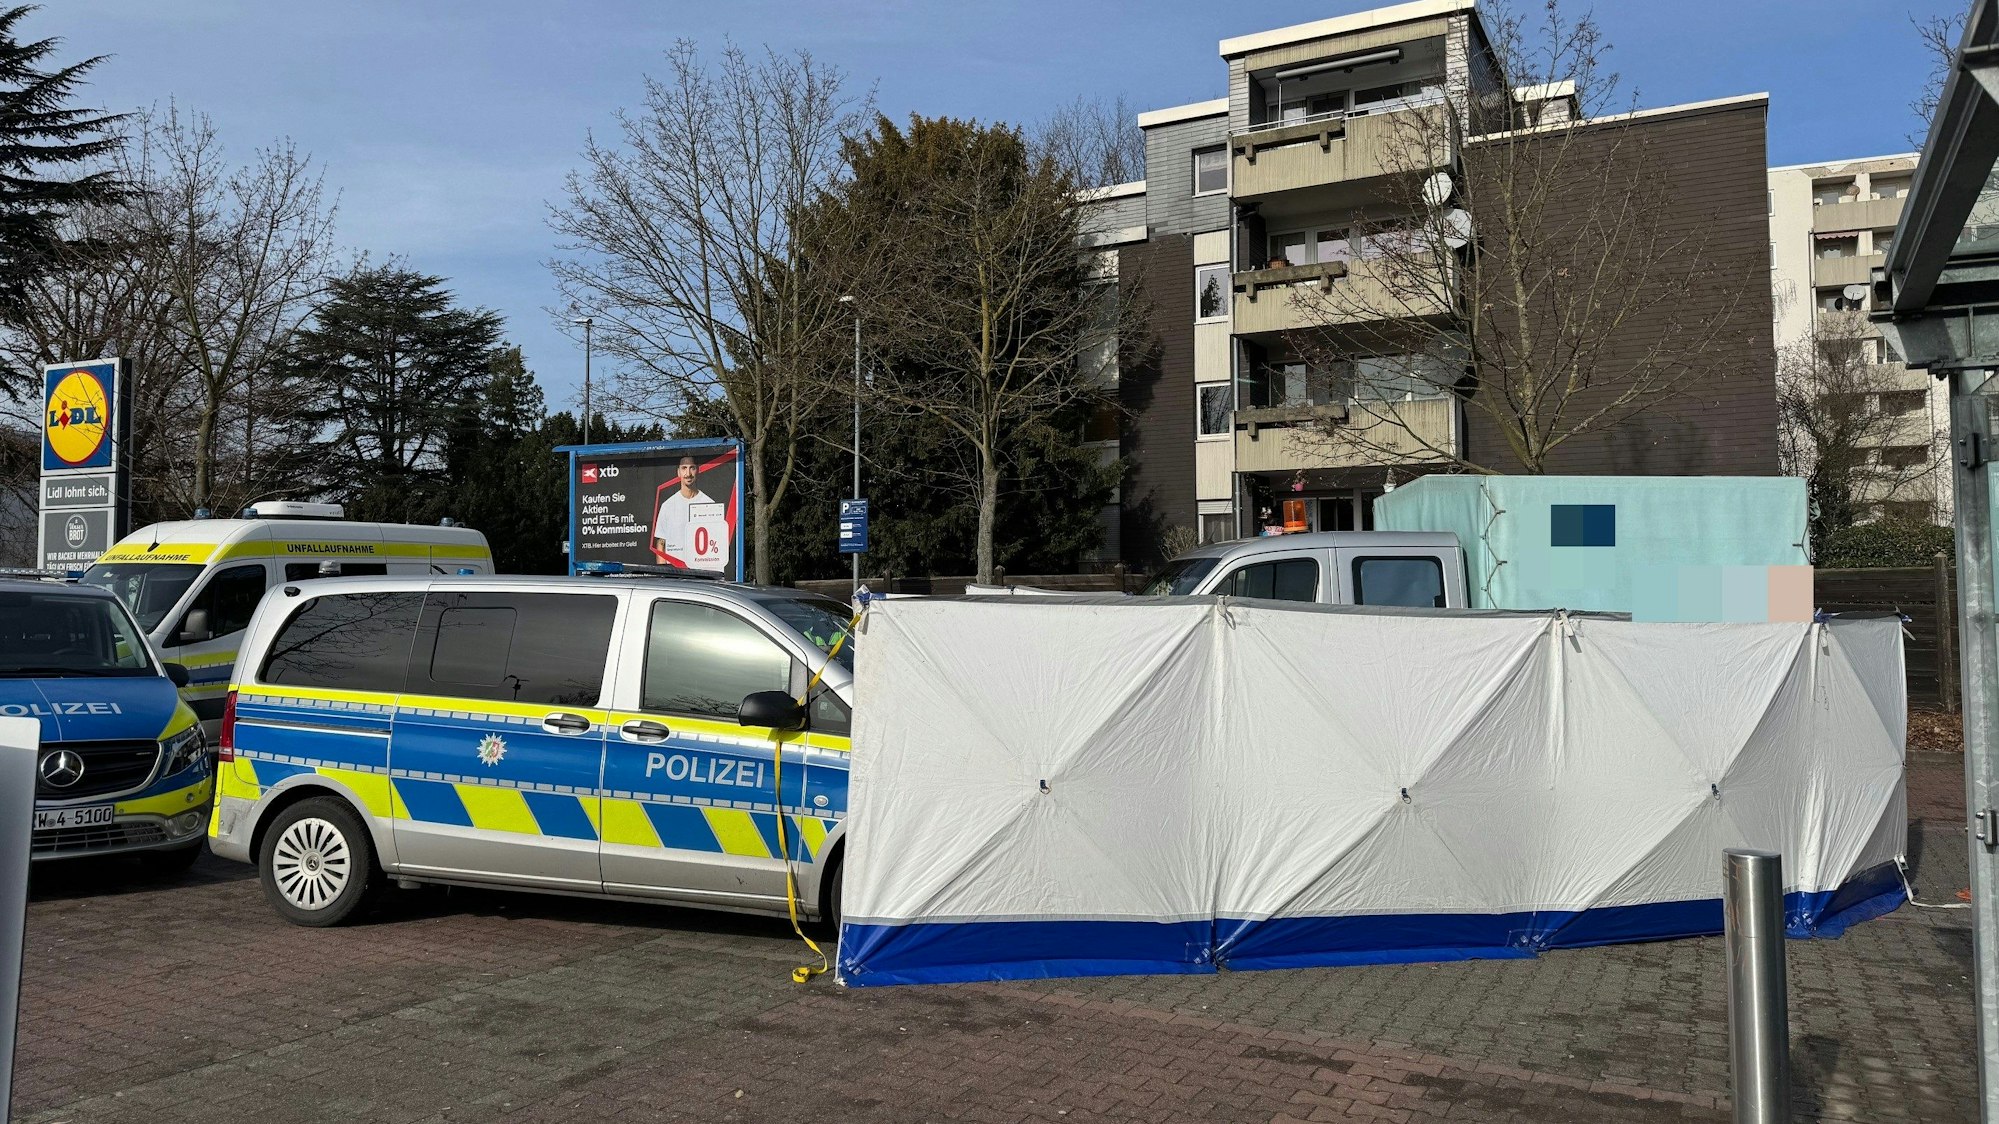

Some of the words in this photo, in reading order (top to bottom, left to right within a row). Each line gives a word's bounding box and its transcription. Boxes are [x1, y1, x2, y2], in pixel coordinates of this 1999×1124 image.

[599, 463, 620, 478] xtb
[47, 487, 62, 499] Lidl
[65, 485, 86, 498] lohnt
[88, 484, 108, 497] sich.
[582, 494, 611, 504] Kaufen
[612, 492, 626, 502] Sie
[582, 504, 609, 514] Aktien
[843, 503, 849, 513] P
[582, 515, 598, 525] und
[600, 514, 620, 524] ETFs
[621, 513, 635, 523] mit
[582, 526, 596, 535] 0%
[597, 523, 648, 535] Kommission
[69, 530, 84, 541] BROT
[287, 543, 374, 553] UNFALLAUFNAHME
[46, 552, 57, 561] WIR
[58, 551, 77, 561] BACKEN
[0, 702, 122, 717] OLIZEI
[645, 752, 764, 788] POLIZEI
